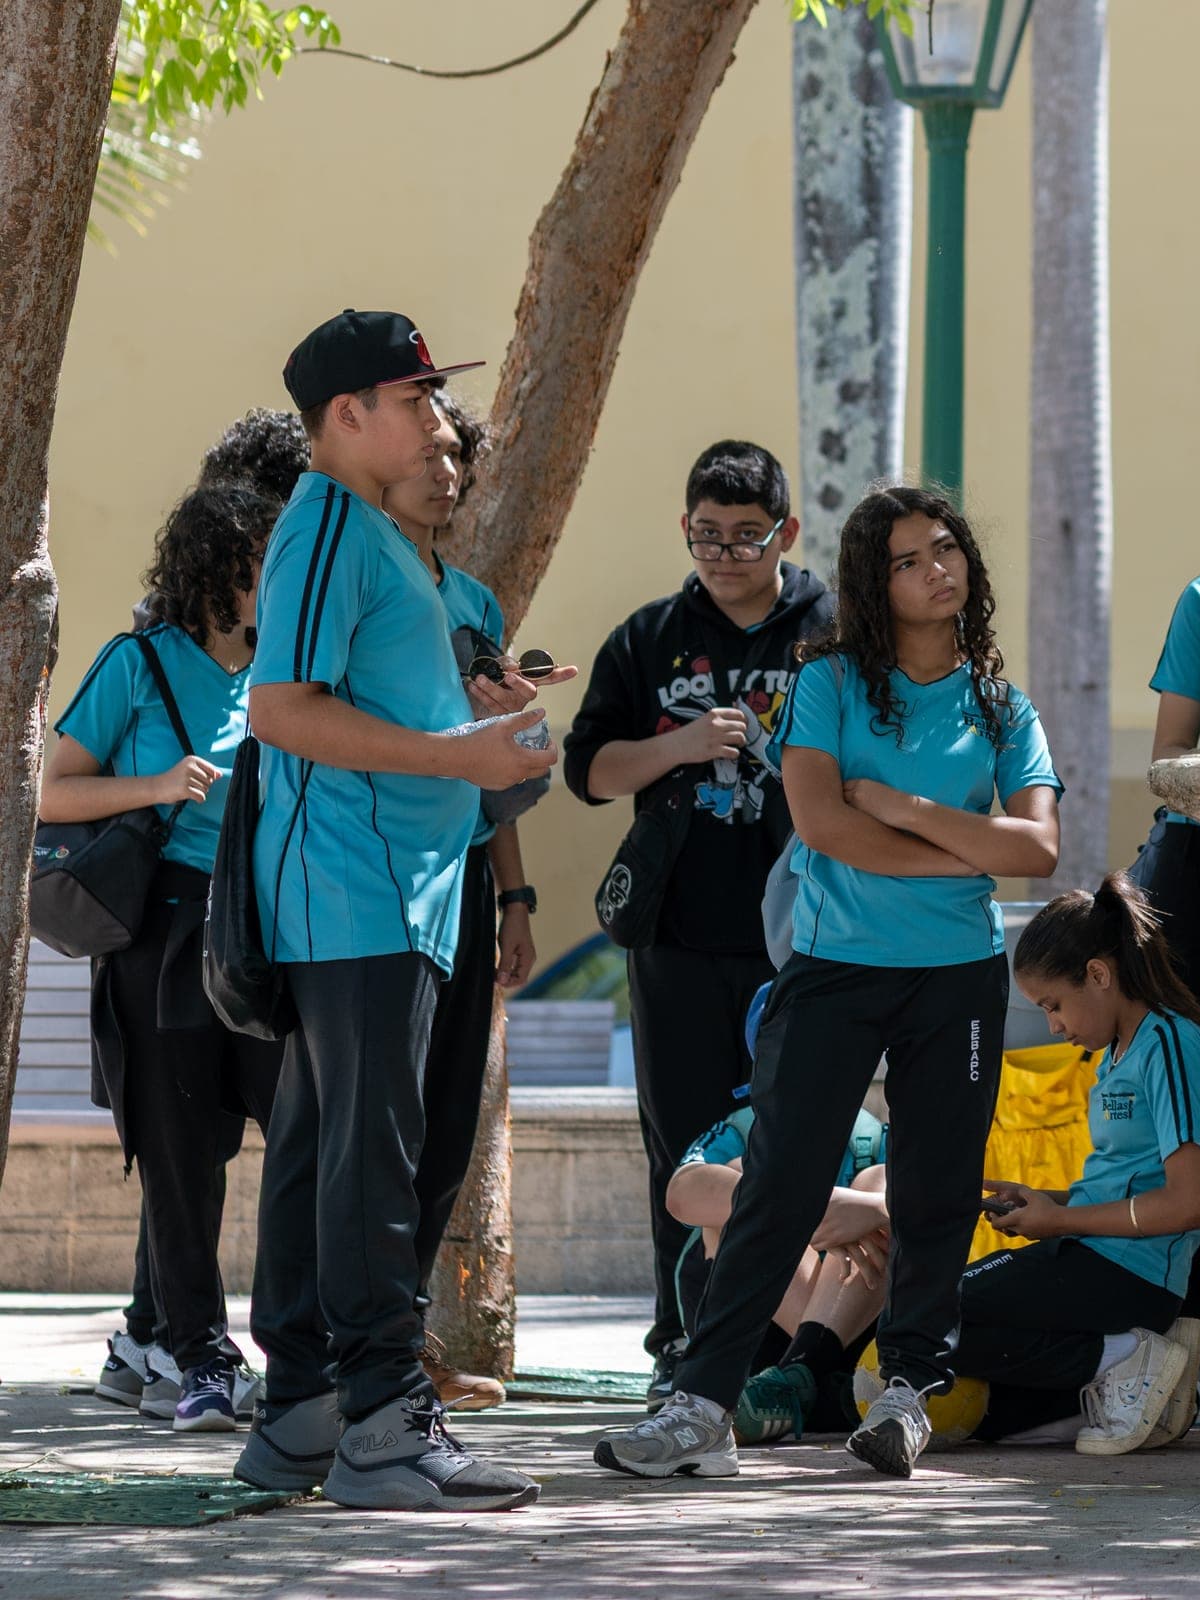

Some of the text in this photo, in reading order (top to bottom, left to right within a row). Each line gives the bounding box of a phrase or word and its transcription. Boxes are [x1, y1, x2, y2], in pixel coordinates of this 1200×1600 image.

[969, 1019, 981, 1081] EEBAPC
[961, 1253, 1014, 1279] EEBAP
[349, 1429, 399, 1457] FILA
[673, 1426, 700, 1449] N
